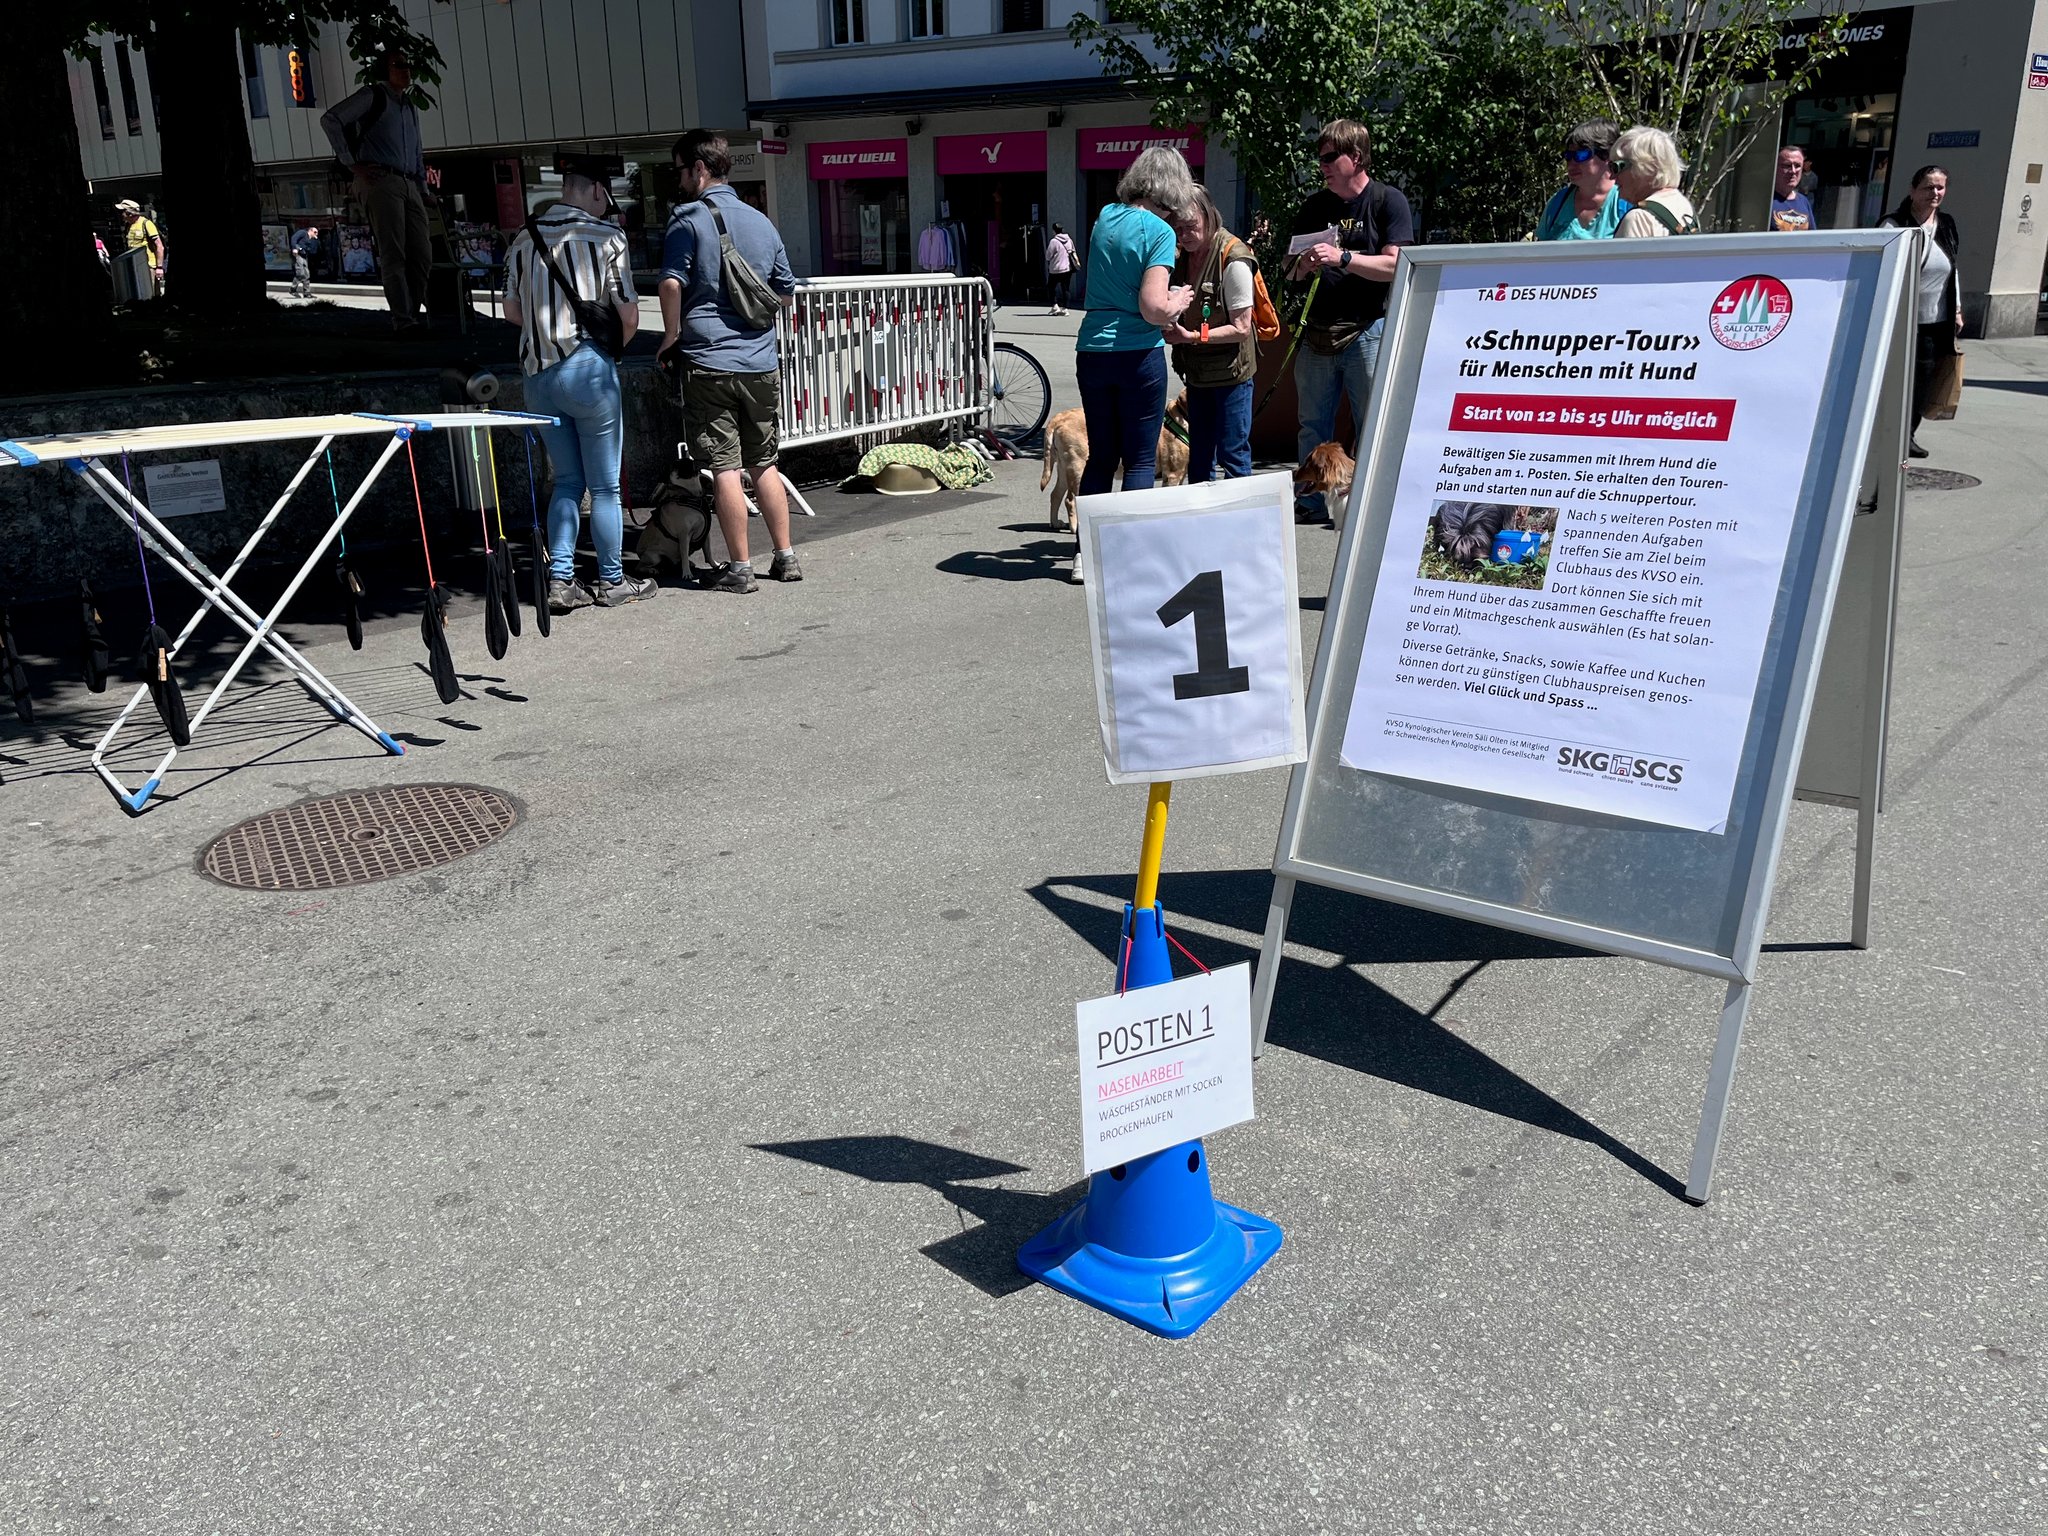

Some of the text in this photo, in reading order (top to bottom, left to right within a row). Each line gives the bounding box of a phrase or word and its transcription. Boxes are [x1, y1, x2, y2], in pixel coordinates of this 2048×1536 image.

[821, 153, 858, 165] TALLY
[1095, 140, 1141, 153] TALLY
[1511, 287, 1536, 300] DES
[1539, 286, 1598, 300] HUNDES
[1743, 325, 1772, 333] OLTEN
[1459, 359, 1697, 380] für Menschen mit Hund
[1462, 405, 1717, 431] Start von 12 bis 15 Uhr möglich
[1442, 446, 1717, 470] Bewältigen Sie zusammen mit Ihrem Hund die
[1438, 462, 1728, 489] Aufgaben am 1. Posten. Sie erhalten den Touren-
[1435, 479, 1696, 507] plan und starten nun auf die Schnuppertour.
[1566, 508, 1738, 531] Nach 5 weiteren Posten mit
[1562, 528, 1703, 548] spannenden Aufgaben
[1559, 544, 1706, 566] treffen Sie am Ziel beim
[1556, 561, 1703, 585] Clubhaus des KVSO ein.
[1413, 585, 1711, 627] Ihrem Hund über das zusammen Geschaffte freuen
[1551, 582, 1703, 608] Dort können Sie sich mit
[1156, 570, 1250, 700] 1
[1405, 620, 1461, 637] ge Vorrat).
[1409, 603, 1714, 646] und ein Mitmachgeschenk auswählen (Es hat solan-
[1402, 638, 1705, 687] Diverse Getränke, Snacks, sowie Kaffee und Kuchen
[1395, 673, 1414, 683] sen
[1417, 676, 1460, 690] werden.
[1464, 680, 1486, 694] Viel
[1487, 684, 1521, 699] Glück
[1522, 691, 1546, 703] und
[1547, 692, 1584, 708] Spass
[1398, 654, 1692, 704] können dort zu günstigen Clubhauspreisen genos-
[1383, 728, 1545, 761] der Schweizerischen Kynologischen Gesellschaft
[1385, 719, 1404, 728] KVSO
[1404, 722, 1451, 735] Kynologischer
[1451, 729, 1473, 739] Verein
[1488, 735, 1508, 745] Olten
[1509, 738, 1519, 747] ist
[1519, 740, 1550, 752] Mitglied
[1557, 746, 1684, 784] SKG SCS
[1097, 1004, 1214, 1060] POSTEN 1
[1098, 1061, 1184, 1098] NASENARBEIT
[1098, 1075, 1223, 1122] WÄSCHESTÄNDER MIT SOCKEN
[1099, 1109, 1174, 1142] BROCKENHAUFEN
